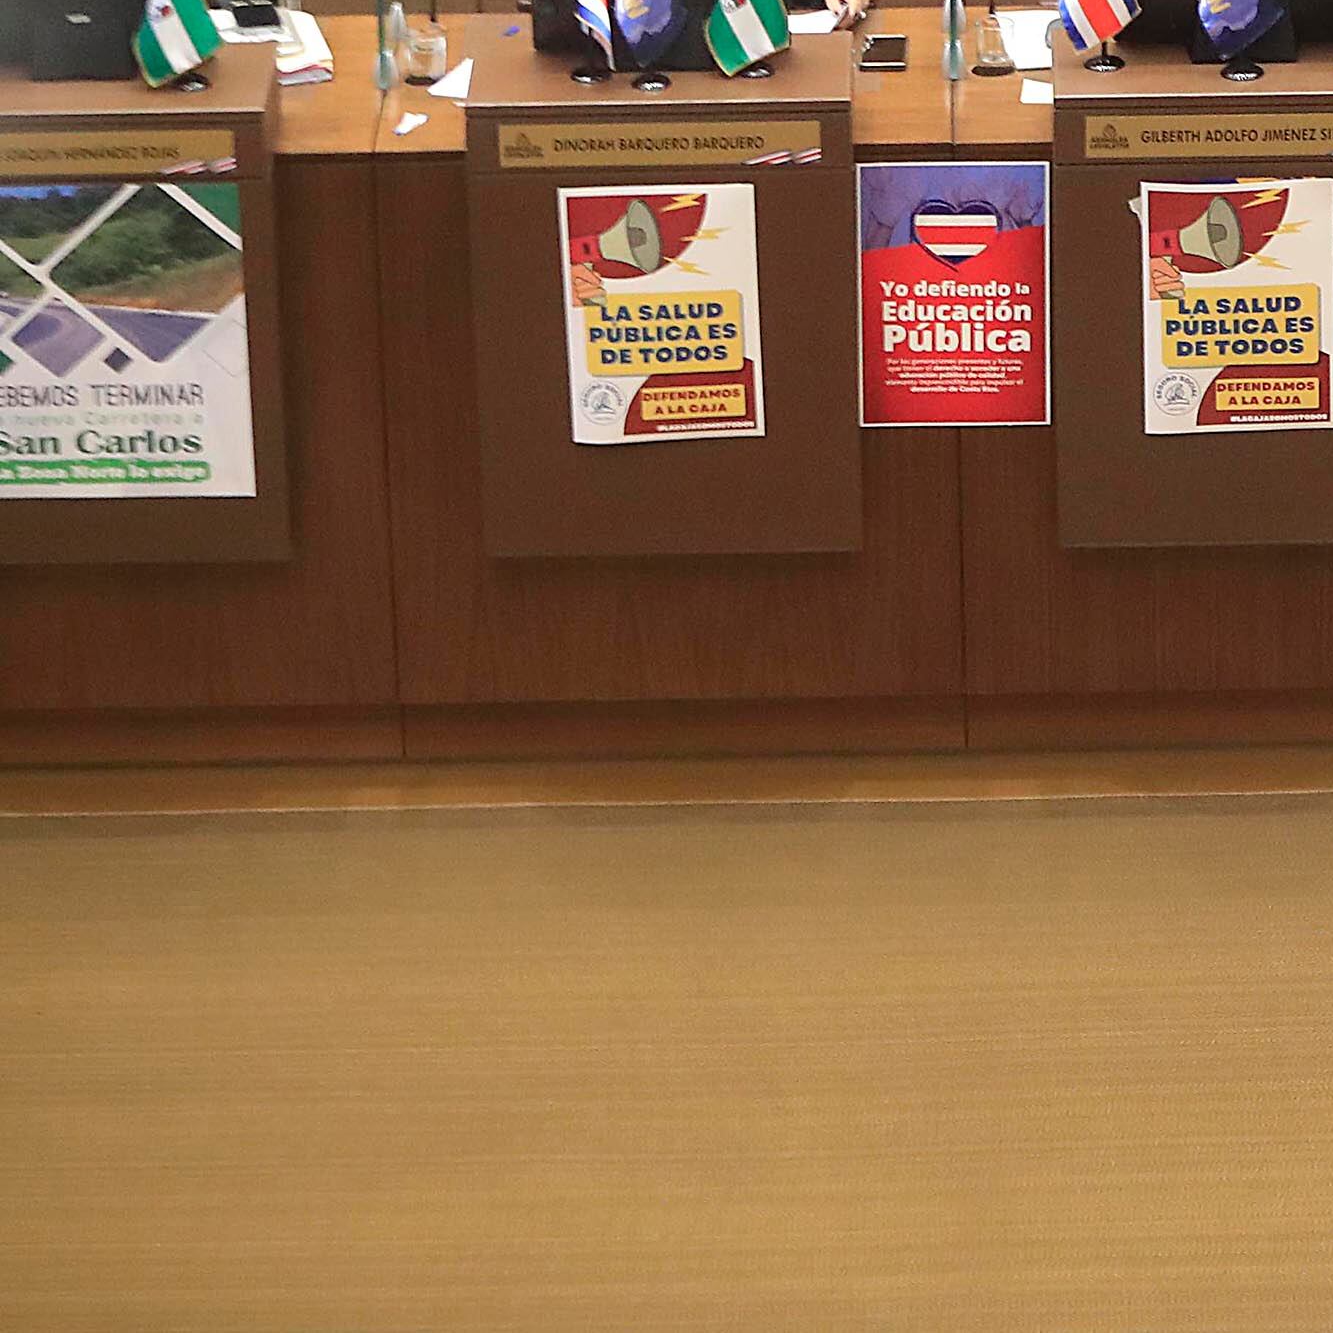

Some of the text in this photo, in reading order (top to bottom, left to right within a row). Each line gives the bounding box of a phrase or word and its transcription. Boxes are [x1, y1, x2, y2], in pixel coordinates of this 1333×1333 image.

[554, 135, 765, 153] DINORAH BARQUERO BARQUERO
[1141, 129, 1200, 144] GILBERTH
[1204, 128, 1257, 143] ADOLFO
[880, 280, 1029, 298] Yo defiendo la
[601, 303, 723, 321] LA SALUD
[882, 300, 1031, 323] Educación
[1179, 296, 1301, 313] LA SALUD
[590, 322, 736, 343] PÚBLICA ES
[1166, 315, 1313, 335] PÚBLICA ES
[883, 322, 1031, 352] Pública
[601, 345, 727, 364] DE TODOS
[1177, 338, 1304, 356] DE TODOS
[0, 384, 204, 407] EBEMOS TERMINAR
[1217, 381, 1315, 393] DEFENDAMOS
[1228, 394, 1300, 405] A LA CAJA
[77, 429, 203, 455] Carlos
